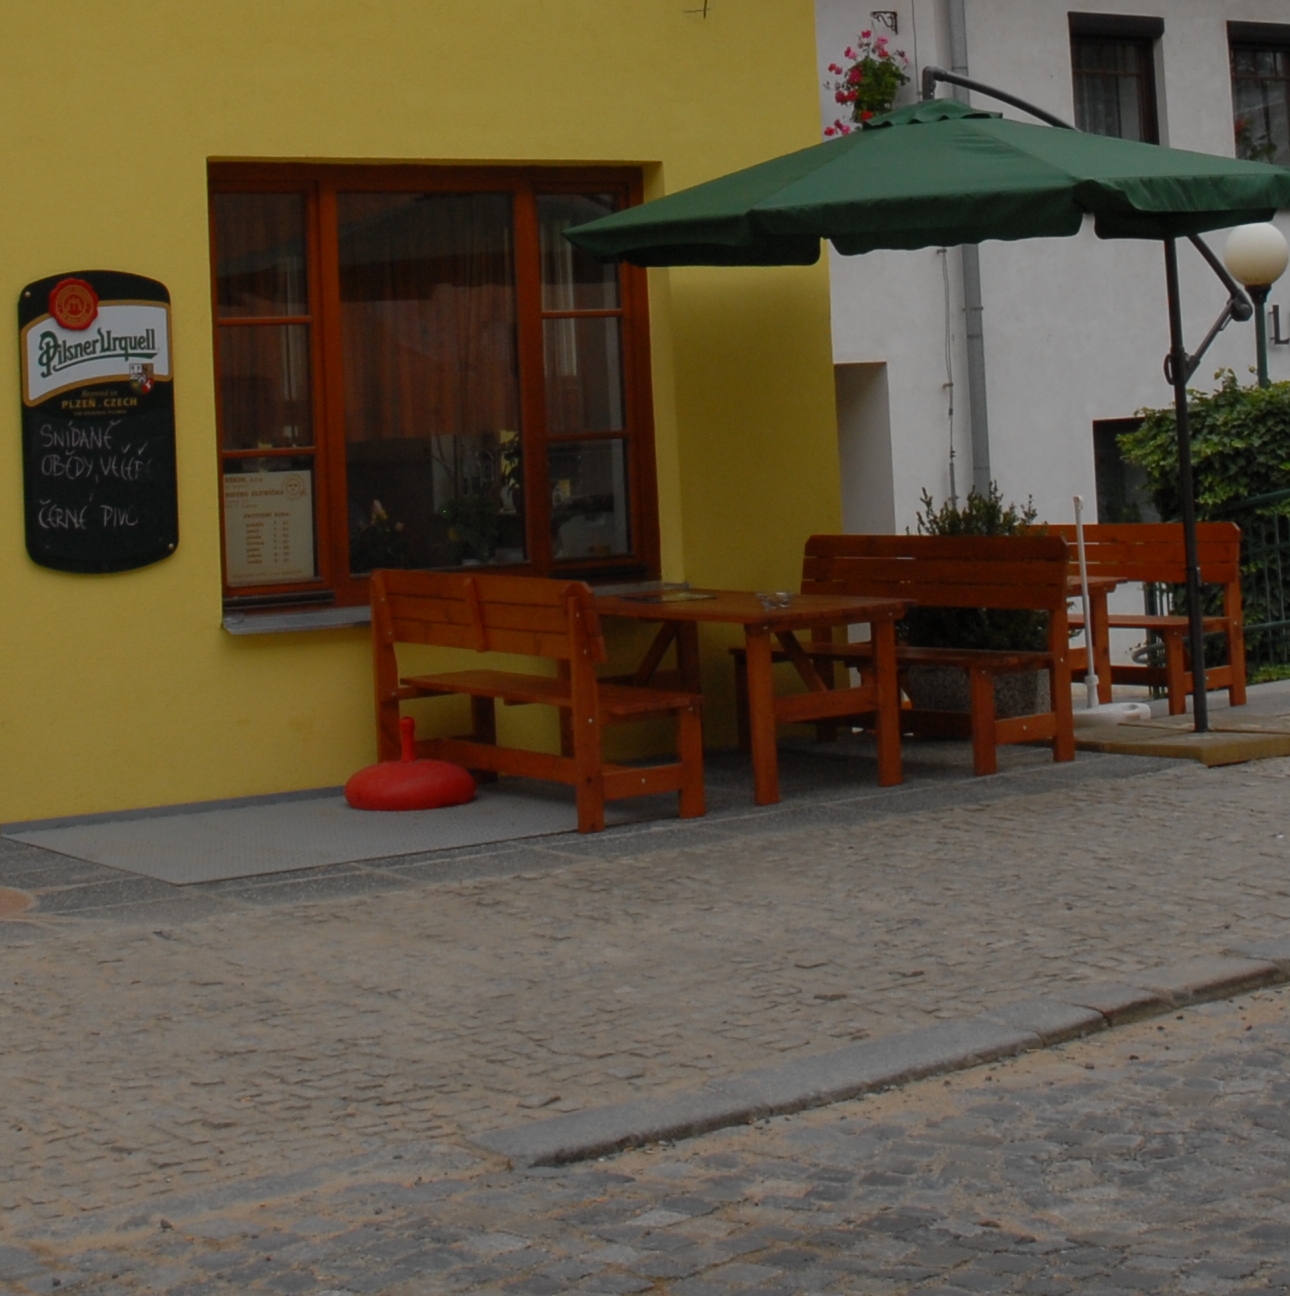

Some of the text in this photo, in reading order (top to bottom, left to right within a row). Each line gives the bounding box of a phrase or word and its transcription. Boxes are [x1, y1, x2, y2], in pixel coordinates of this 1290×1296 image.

[38, 327, 156, 378] Pilsner Urquell
[103, 397, 137, 408] CZECH
[40, 419, 122, 450] SNÍDANĚ
[38, 492, 93, 530] ČERNÉ
